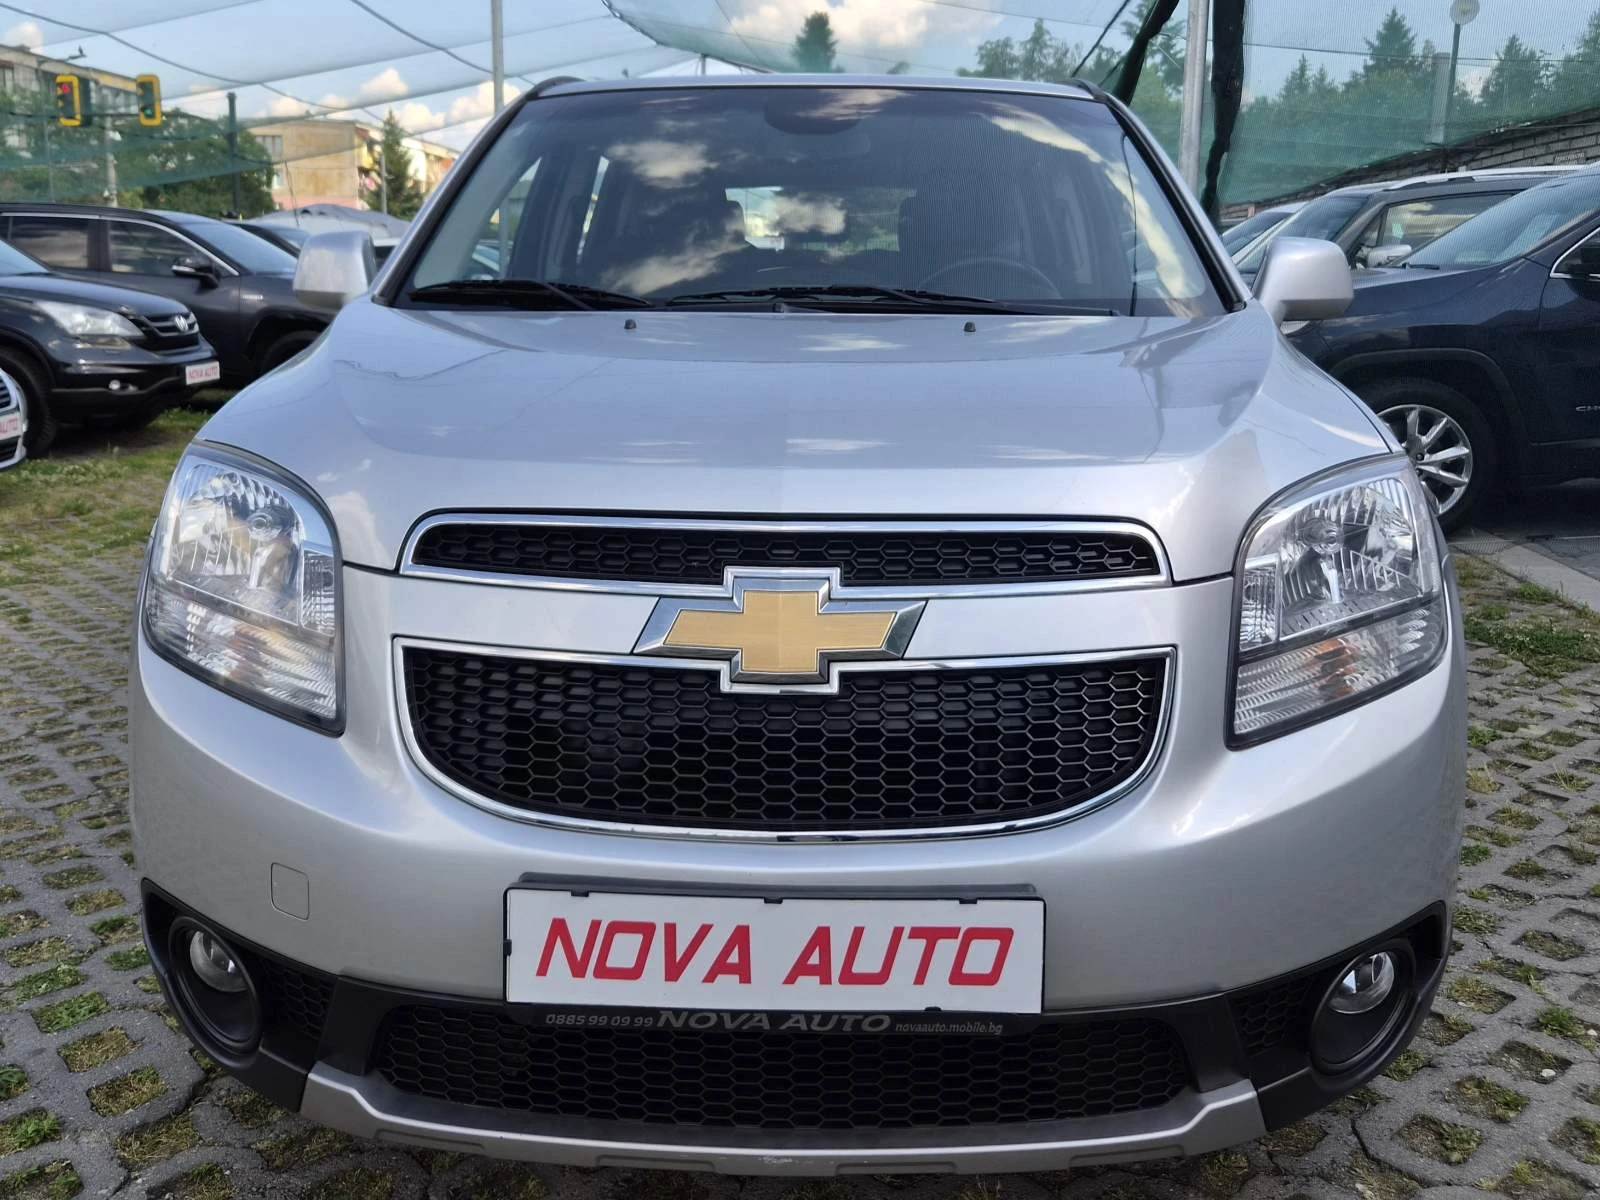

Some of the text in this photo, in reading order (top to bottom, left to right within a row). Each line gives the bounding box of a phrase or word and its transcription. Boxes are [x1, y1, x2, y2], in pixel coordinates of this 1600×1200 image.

[536, 918, 1014, 986] NOVA AUTO
[545, 1010, 1003, 1035] 0885 99 09 99 NOVA AUTO novaauto.mobile.bg
